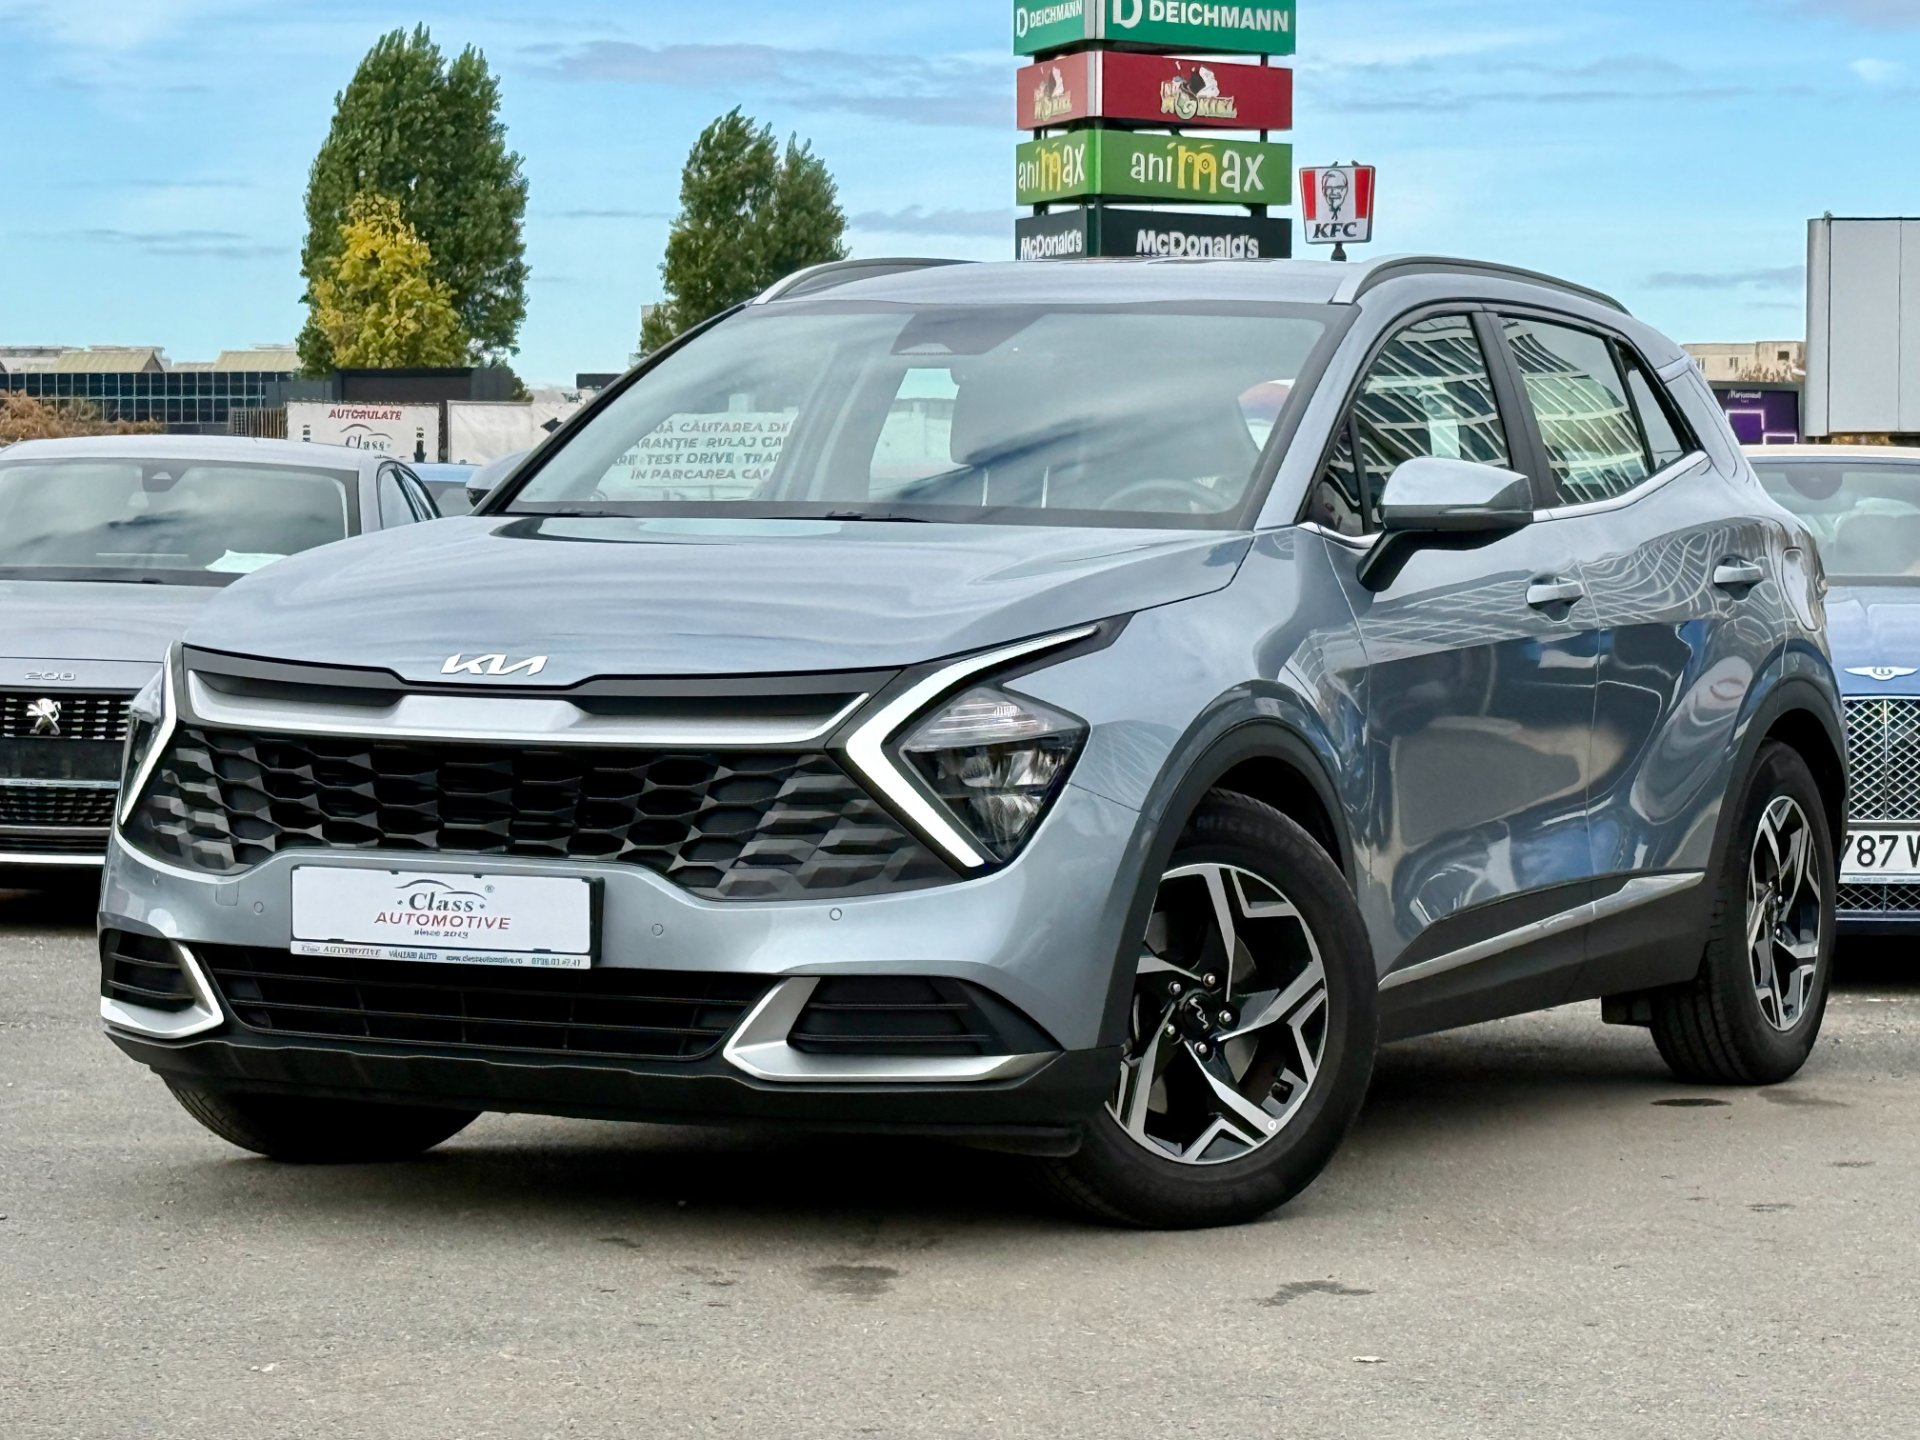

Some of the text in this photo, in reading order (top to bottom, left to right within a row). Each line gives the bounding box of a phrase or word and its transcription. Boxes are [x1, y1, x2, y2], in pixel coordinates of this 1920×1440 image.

[1030, 1, 1082, 28] DEICHMANN
[1150, 1, 1288, 32] DEICHMANN
[1018, 142, 1085, 192] animax
[1130, 142, 1265, 194] animax
[1312, 221, 1357, 239] KFC
[1020, 229, 1082, 261] McDonald's
[1136, 229, 1259, 259] McDonald's
[647, 453, 682, 465] TEST
[686, 452, 734, 465] DRIVE
[650, 467, 736, 480] PARCAREA
[409, 891, 474, 912] Class
[374, 912, 511, 930] AUTOMOTIVE
